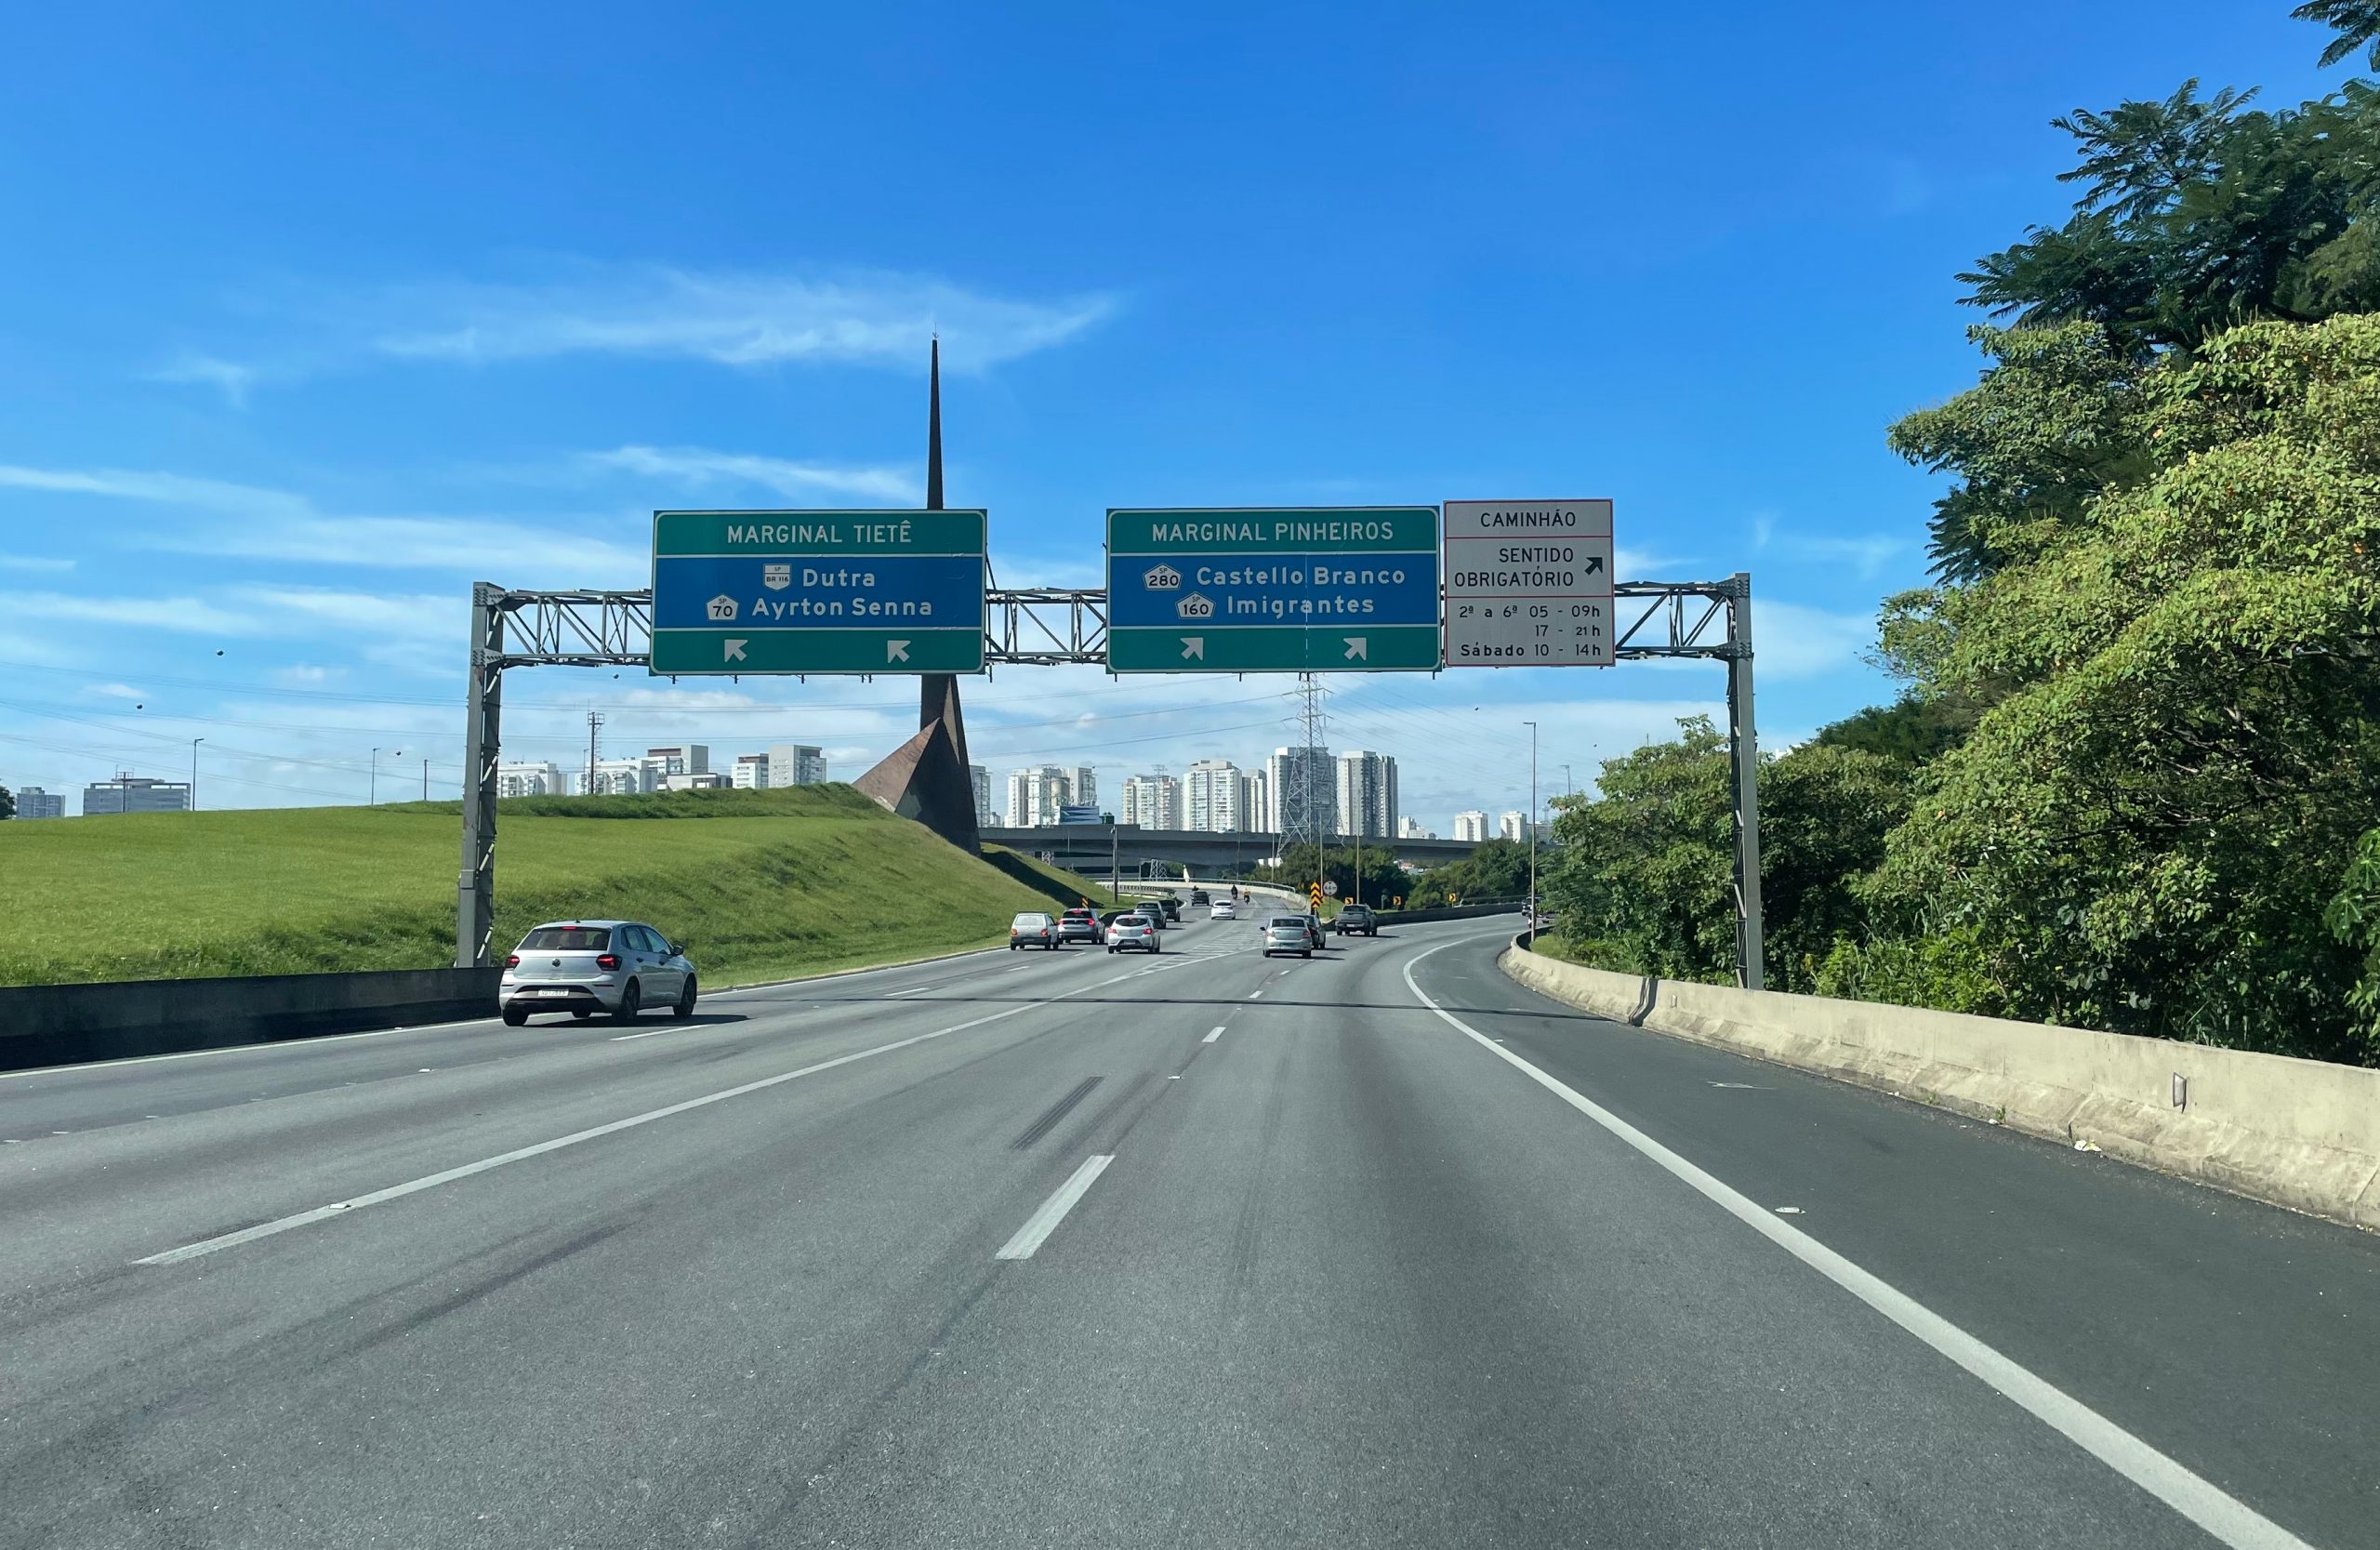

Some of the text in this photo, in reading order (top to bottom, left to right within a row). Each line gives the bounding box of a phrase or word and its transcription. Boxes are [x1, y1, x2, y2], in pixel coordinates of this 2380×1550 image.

[728, 520, 912, 544] MARGINAL TIETÊ
[1152, 522, 1394, 542] MARGINAL PINHEIROS
[1499, 548, 1574, 563] SENTIDO
[802, 568, 876, 587] Dutra
[1149, 576, 1179, 586] 280
[1197, 566, 1406, 586] Castello Branco
[1454, 565, 1574, 587] OBRIGATÓRIO
[712, 605, 733, 616] 70
[752, 598, 932, 620] Ayrton Senna
[1183, 603, 1209, 615] 160
[1227, 596, 1374, 619] Imigrantes
[1460, 605, 1474, 617] 2ª
[1485, 608, 1492, 617] a
[1503, 605, 1517, 617] 6ª
[1529, 605, 1548, 617] 05
[1571, 605, 1600, 617] 09h
[1536, 625, 1549, 637] 17
[1461, 642, 1525, 656] Sábado
[1535, 643, 1549, 656] 10
[1576, 643, 1601, 656] 14h
